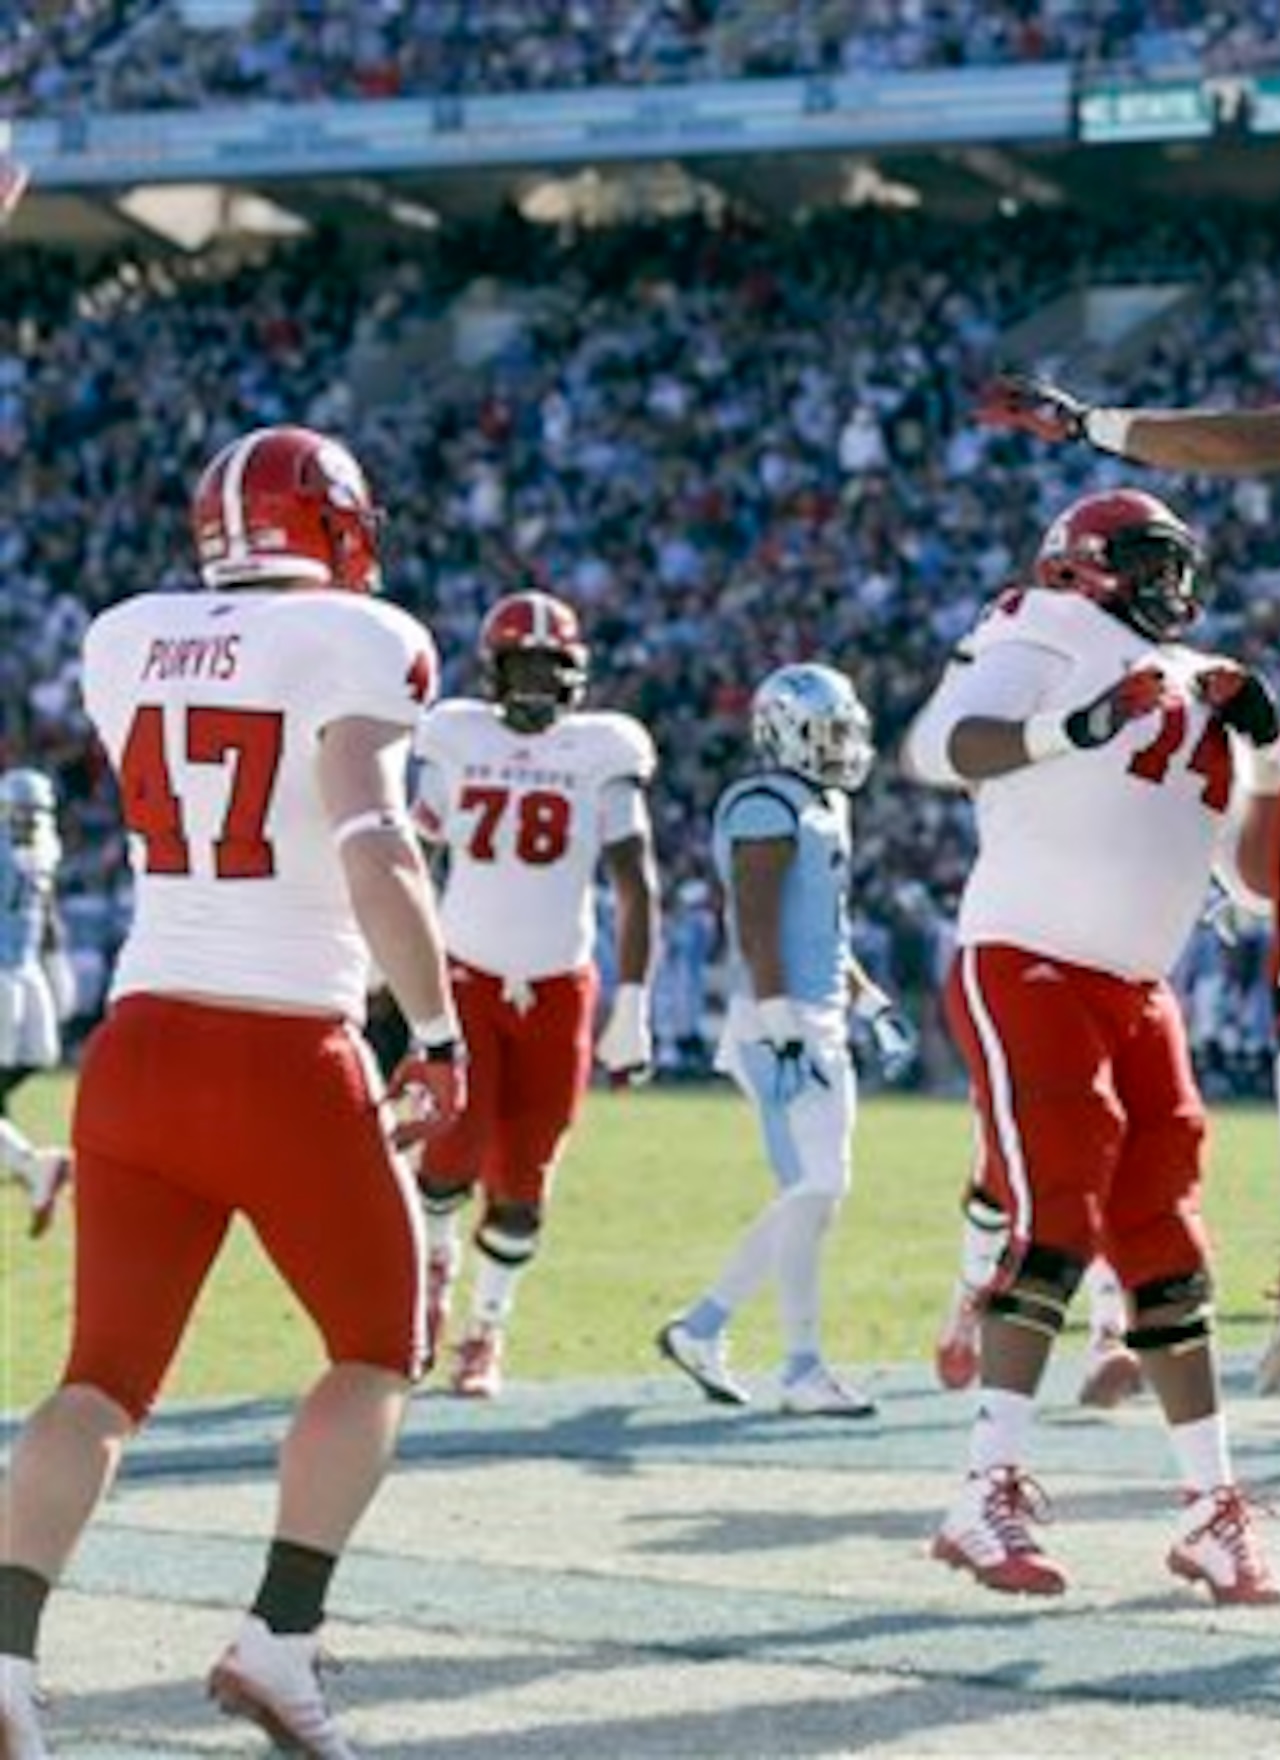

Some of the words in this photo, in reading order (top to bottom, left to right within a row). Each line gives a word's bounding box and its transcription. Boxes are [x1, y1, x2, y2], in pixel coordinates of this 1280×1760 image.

[141, 634, 241, 681] PURVIS
[119, 705, 285, 880] 47
[459, 785, 570, 865] 78
